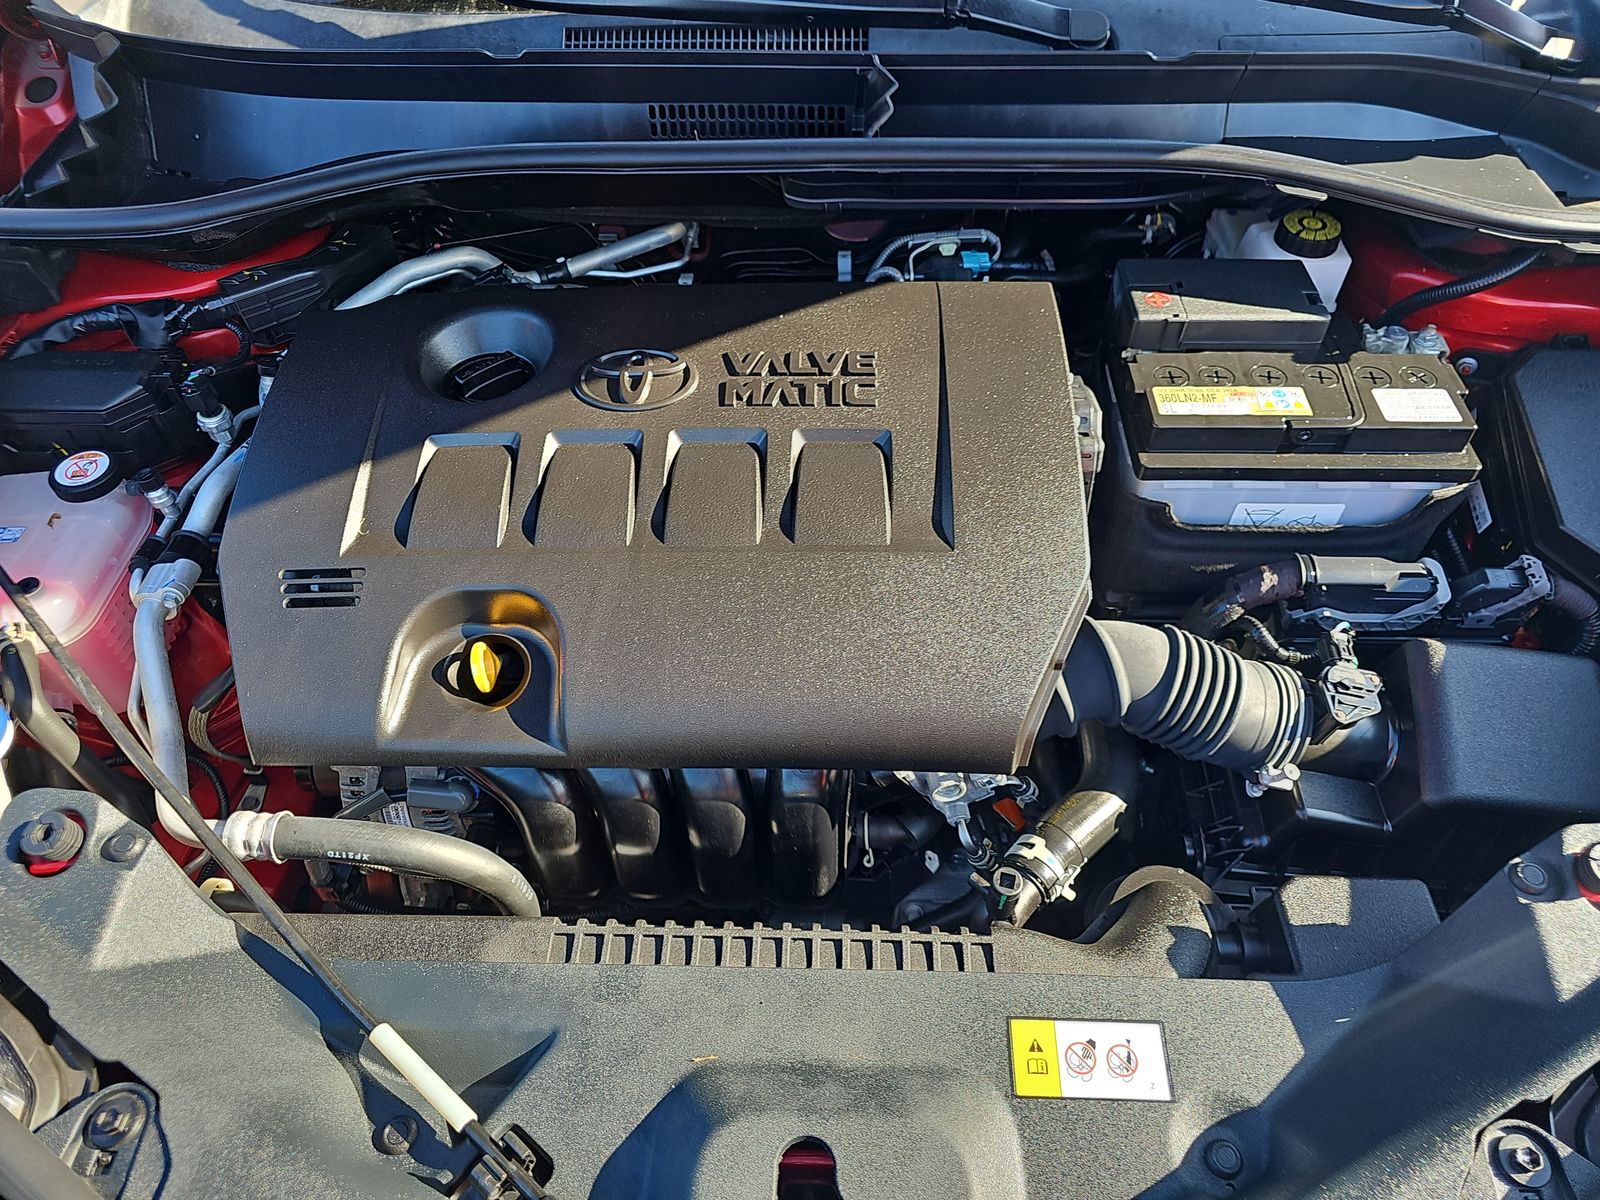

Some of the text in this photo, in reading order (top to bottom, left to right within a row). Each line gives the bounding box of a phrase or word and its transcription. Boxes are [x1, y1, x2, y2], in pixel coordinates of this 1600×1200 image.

[721, 350, 877, 377] VALVE
[718, 378, 877, 408] MATIC
[1158, 393, 1217, 403] 360LN2-MF
